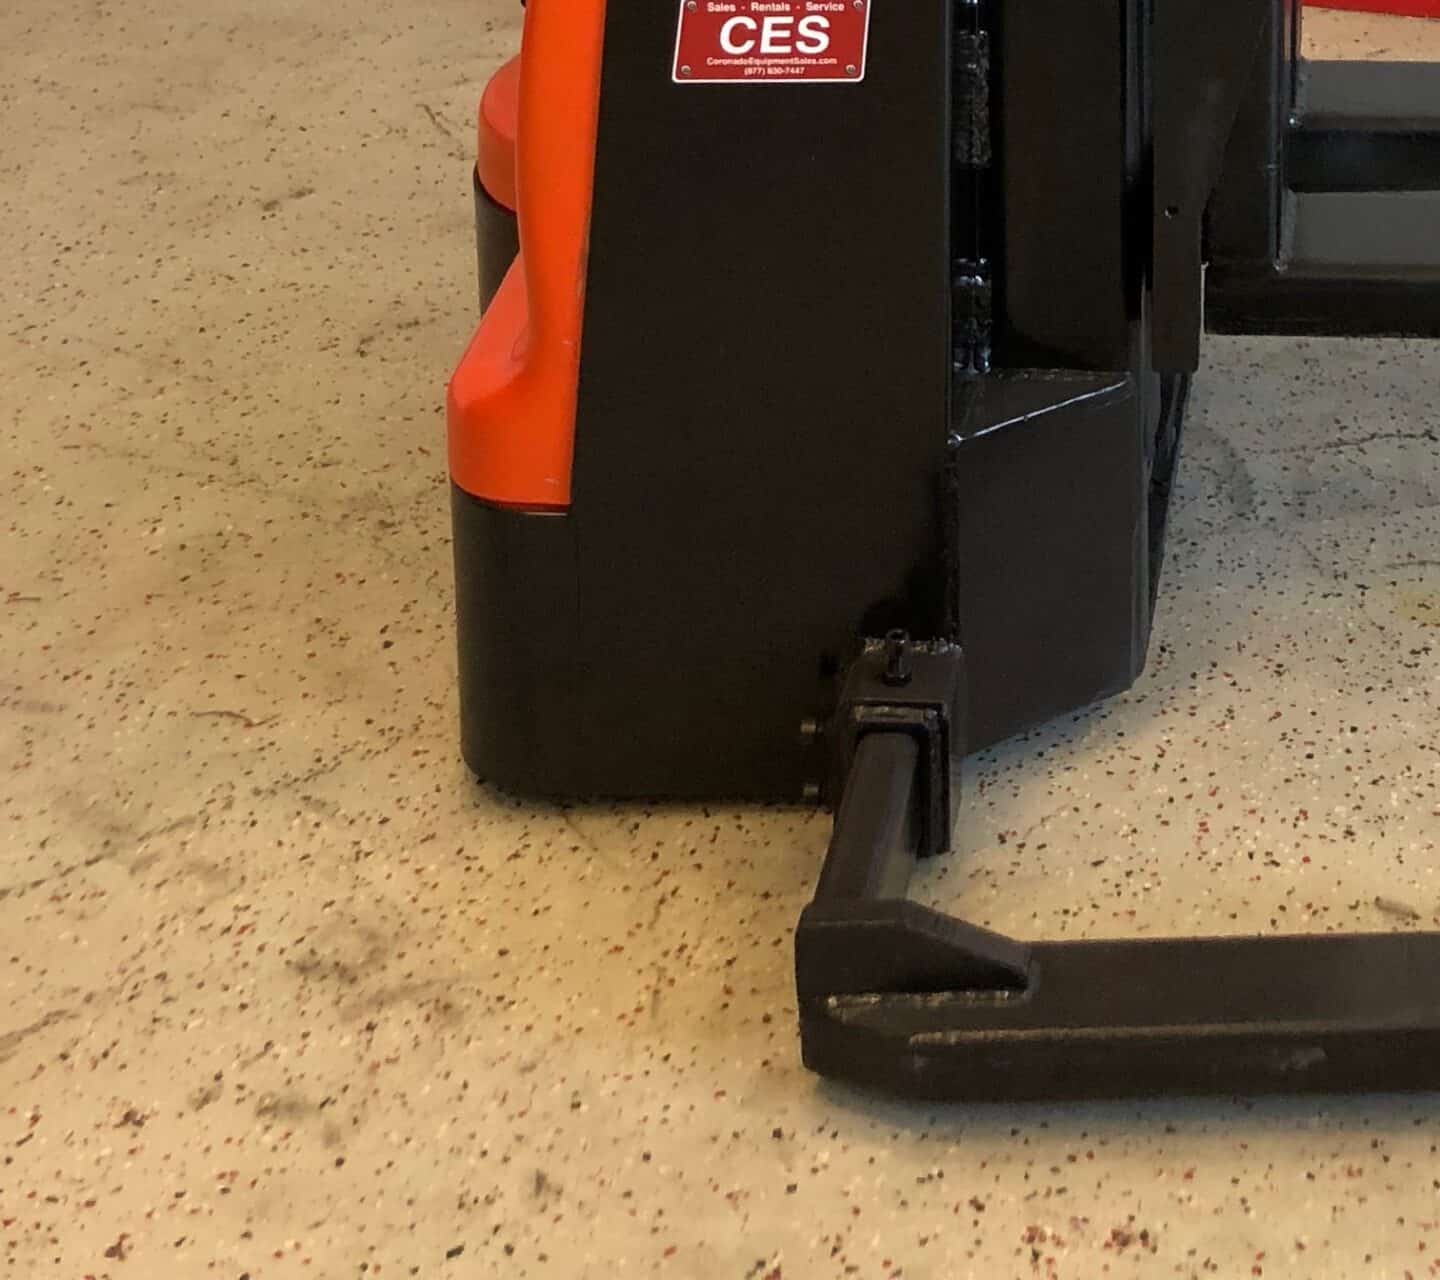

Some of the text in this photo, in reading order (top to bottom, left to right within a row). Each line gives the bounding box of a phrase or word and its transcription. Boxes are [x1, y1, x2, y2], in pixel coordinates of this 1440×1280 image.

[707, 1, 736, 12] Sales
[751, 1, 791, 12] Rentals
[806, 1, 844, 12] Service
[719, 15, 831, 55] CES
[706, 56, 838, 66] CoronadoEquipmentSales.com
